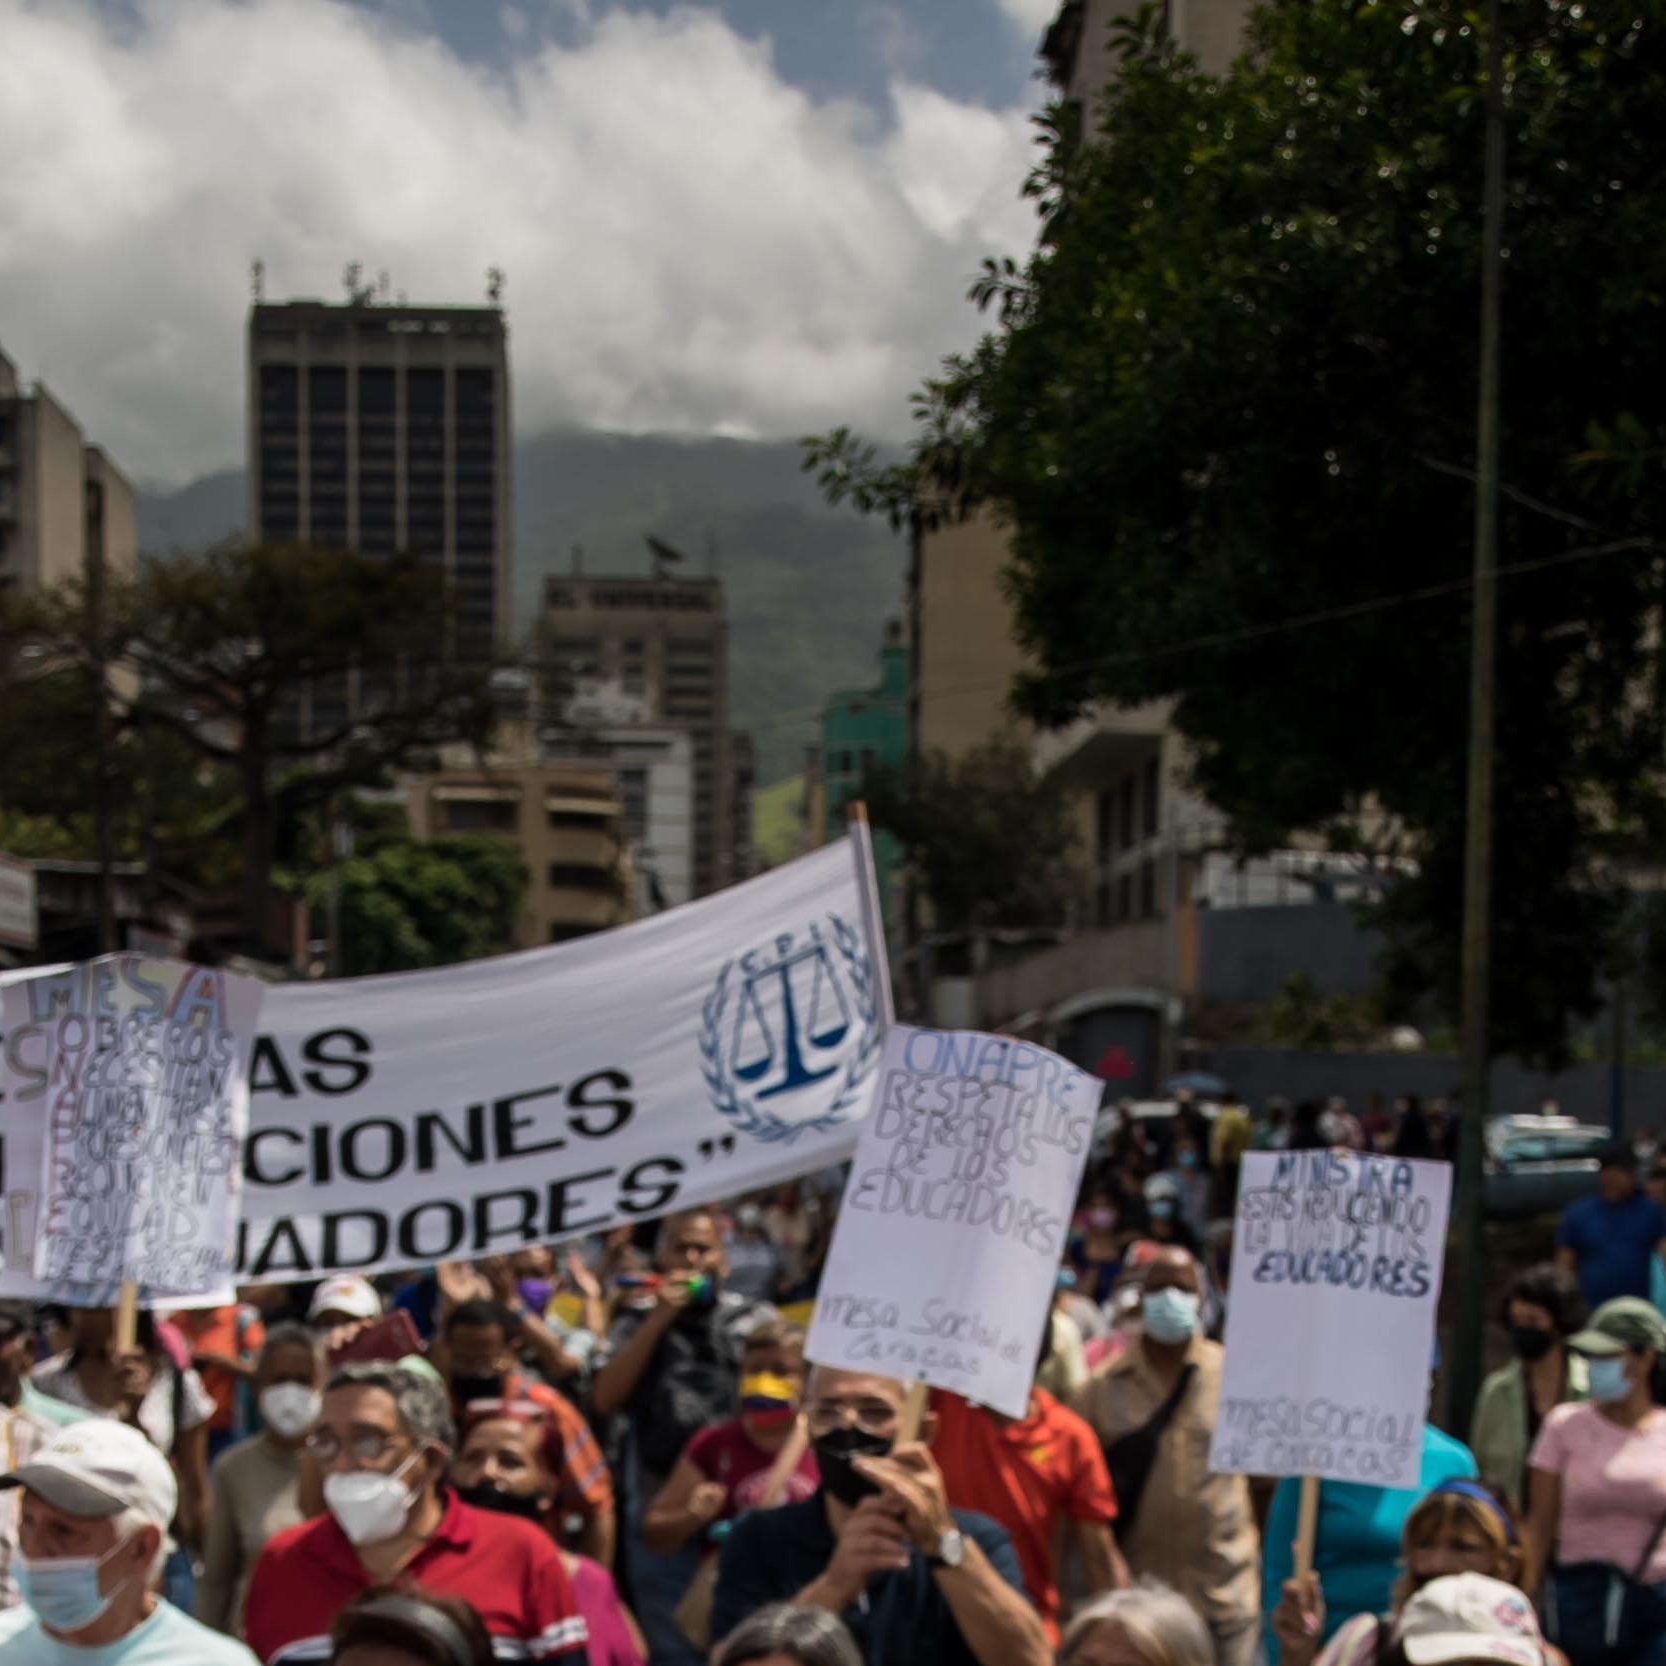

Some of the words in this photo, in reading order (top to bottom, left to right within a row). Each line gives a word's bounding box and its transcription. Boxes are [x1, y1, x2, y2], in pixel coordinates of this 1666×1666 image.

[904, 1028, 1083, 1112] ONAPRE
[889, 1140, 927, 1176] DE
[849, 1168, 1064, 1257] EDUCADORES
[1252, 1249, 1431, 1298] EDUCADORES
